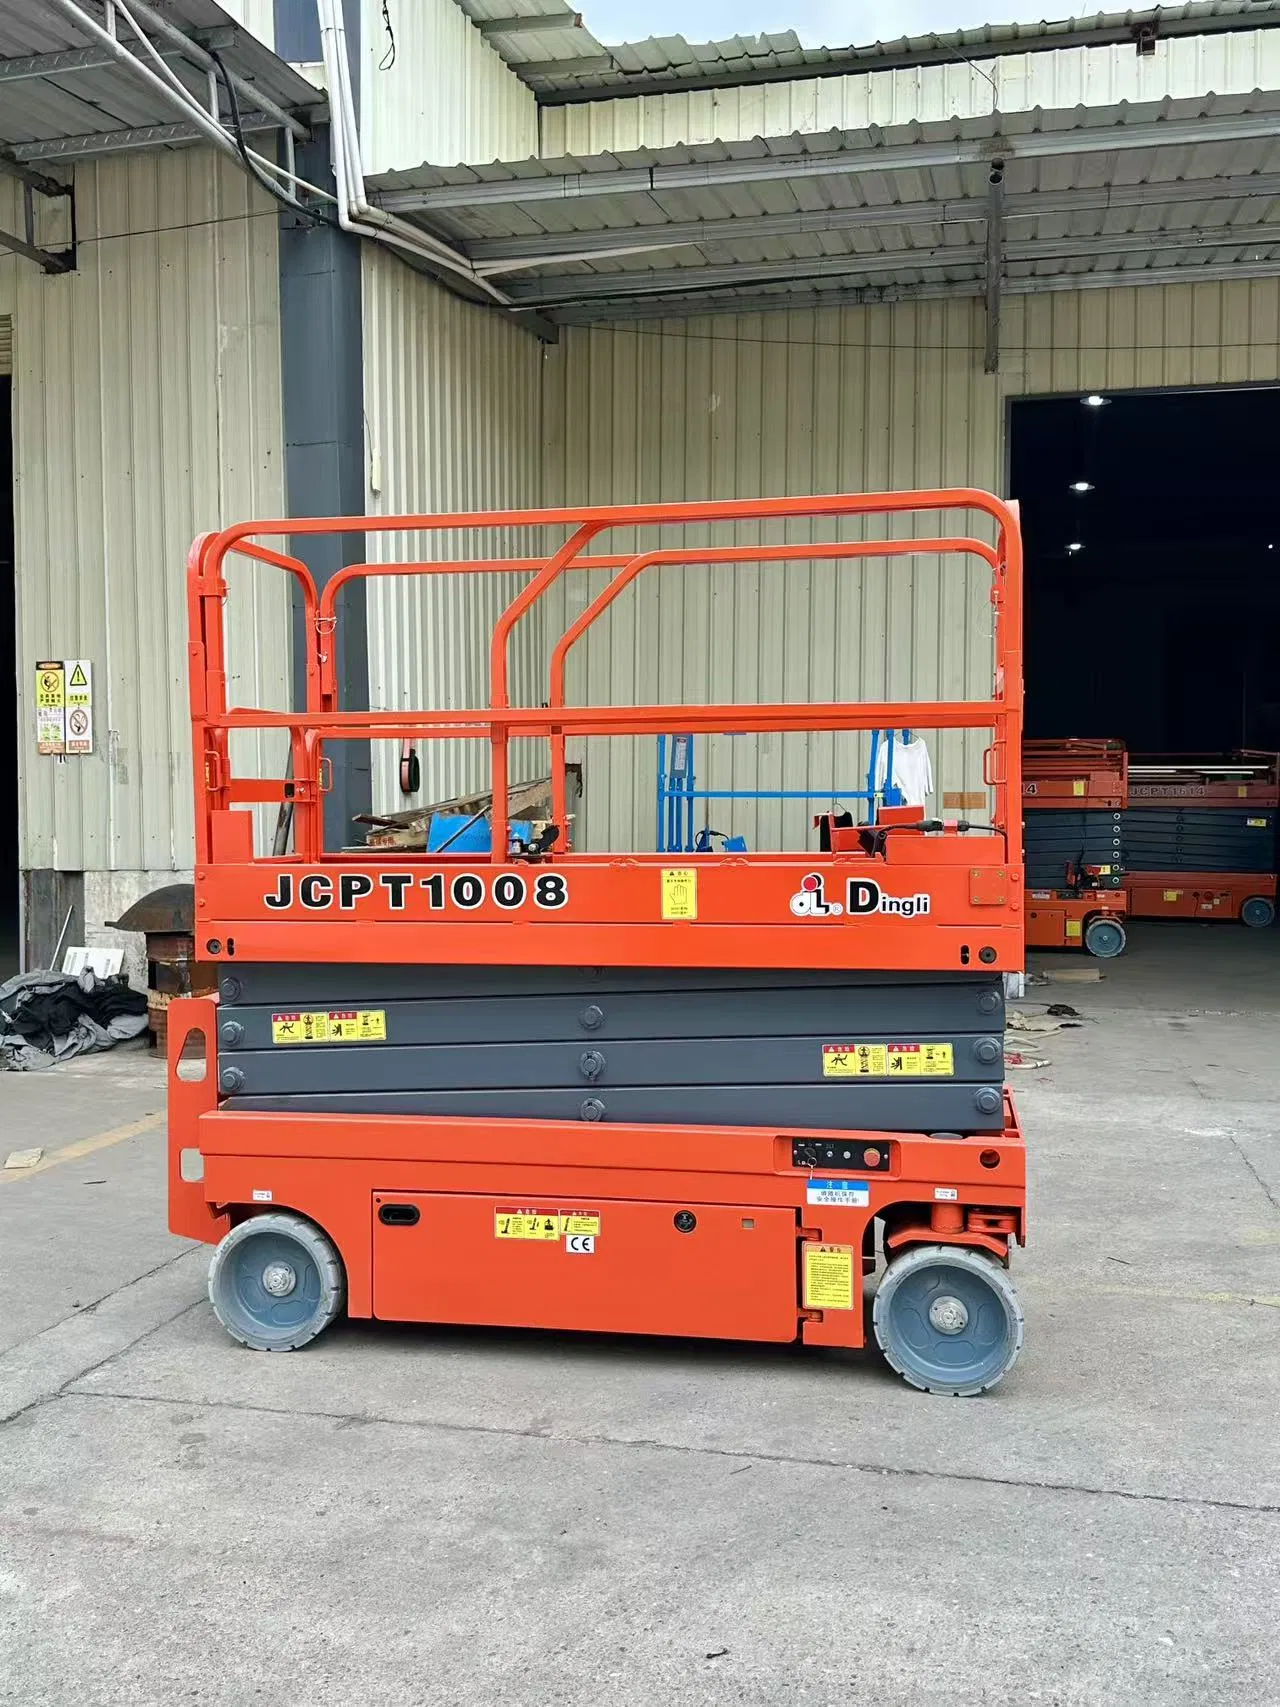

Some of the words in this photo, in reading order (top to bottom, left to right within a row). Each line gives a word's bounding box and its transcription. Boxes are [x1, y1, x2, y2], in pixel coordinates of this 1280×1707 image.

[1130, 785, 1205, 797] JCPT1614
[264, 873, 568, 909] JCPT1008
[848, 878, 929, 917] Dingli
[570, 1236, 590, 1251] CE
